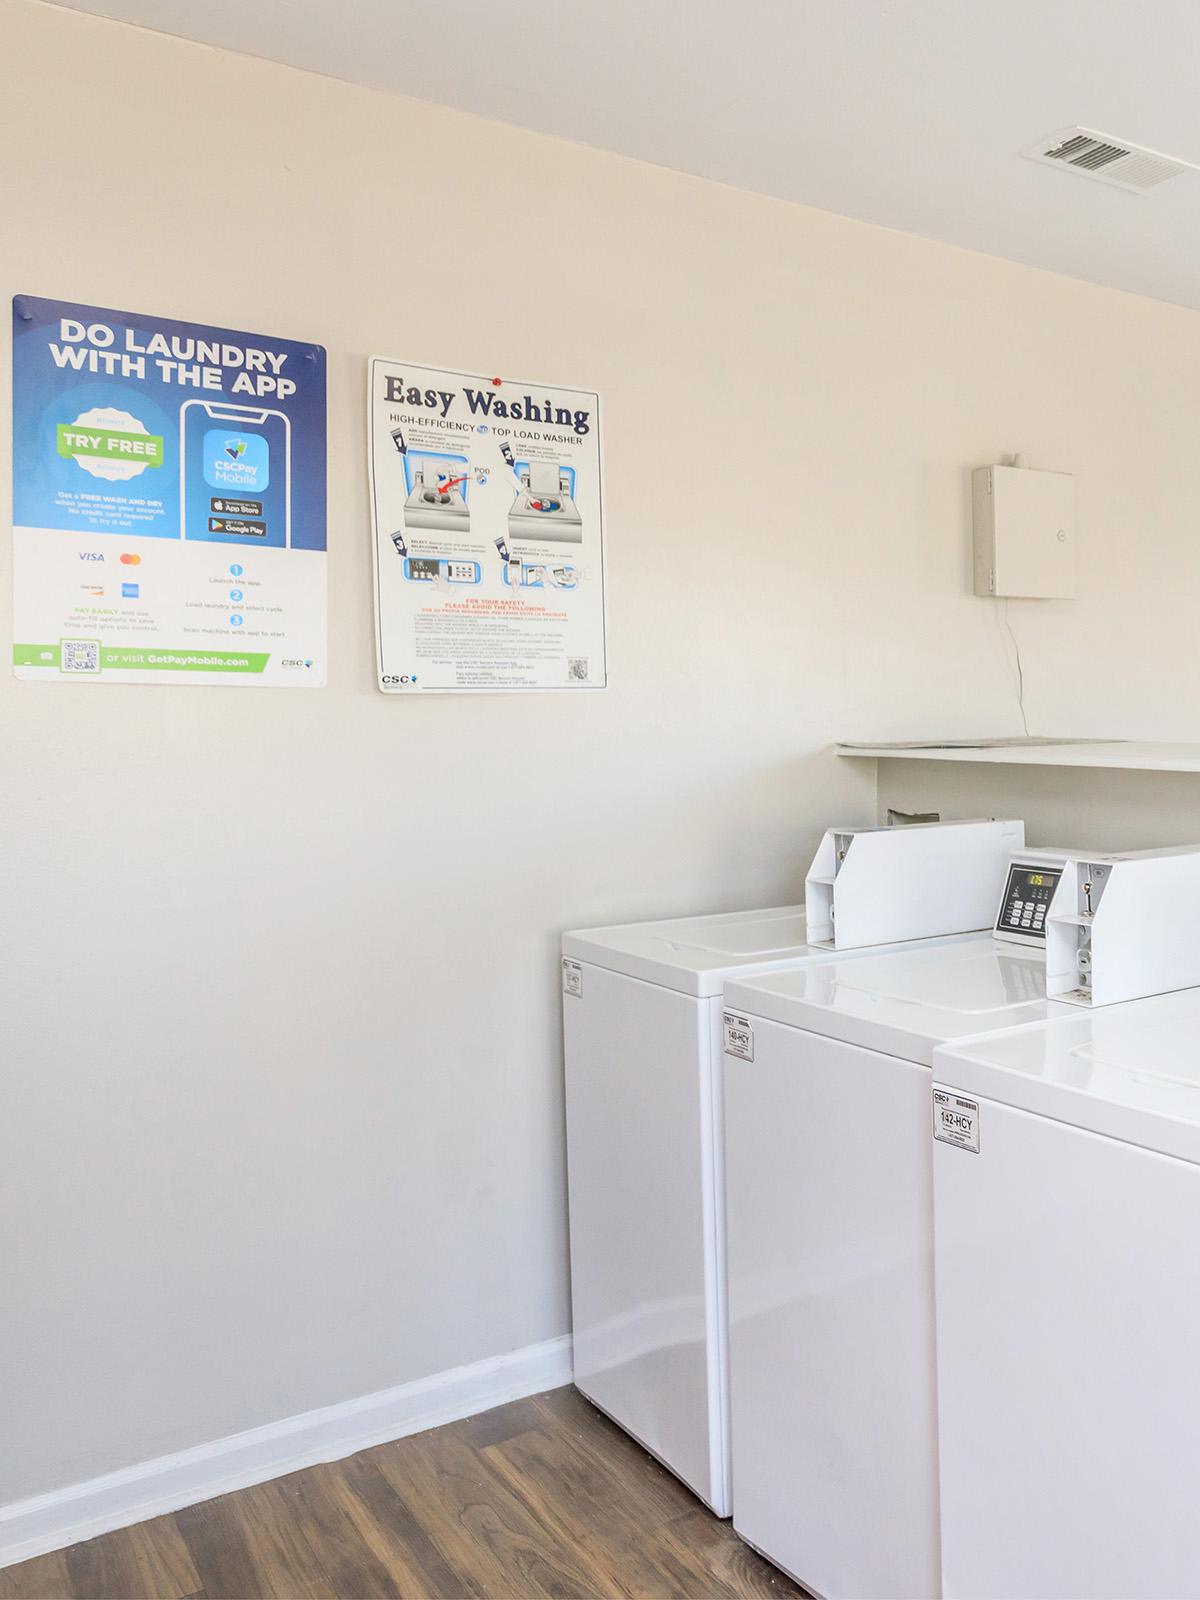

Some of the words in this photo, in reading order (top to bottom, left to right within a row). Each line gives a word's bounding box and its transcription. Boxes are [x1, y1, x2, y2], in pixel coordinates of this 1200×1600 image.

[60, 318, 115, 348] DO
[125, 328, 288, 375] LAUNDRY
[48, 342, 145, 380] WITH
[156, 359, 223, 391] THE
[231, 372, 297, 400] APP
[384, 375, 456, 418] Easy
[462, 387, 590, 435] Washing
[390, 414, 475, 433] HIGH-EFFICIENCY
[492, 427, 512, 436] TOP
[514, 430, 539, 440] LOAD
[542, 432, 583, 446] WASHER
[63, 432, 102, 449] TRY
[107, 438, 157, 456] FREE
[214, 460, 257, 475] CSCPay
[215, 470, 257, 486] Mobile
[225, 505, 240, 513] App
[240, 506, 260, 514] Store
[225, 524, 249, 533] Google
[250, 526, 264, 535] Play
[79, 552, 104, 562] VISA
[122, 654, 145, 663] visit
[148, 654, 249, 667] GetPayMobile.com
[382, 675, 409, 684] CSC
[941, 1111, 973, 1131] 142-HCY
